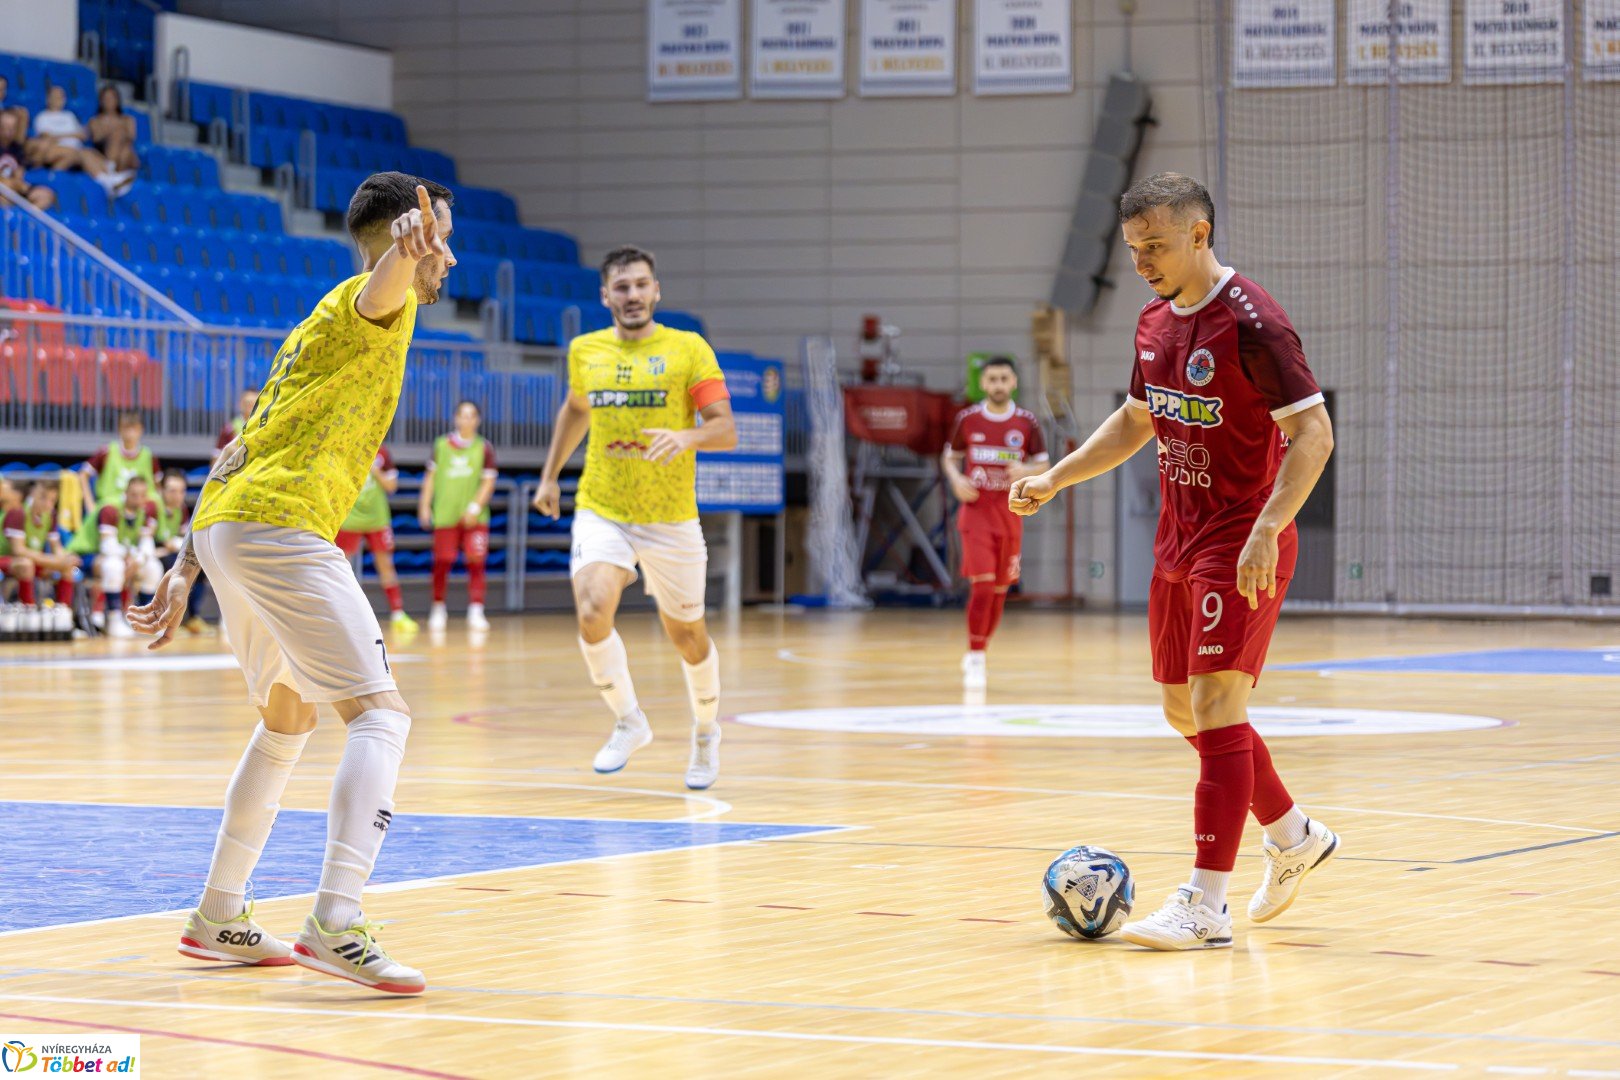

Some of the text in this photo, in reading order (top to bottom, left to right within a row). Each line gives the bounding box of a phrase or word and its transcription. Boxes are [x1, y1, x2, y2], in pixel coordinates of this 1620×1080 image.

[1141, 350, 1155, 361] JAKO
[1202, 592, 1223, 632] 9
[1198, 644, 1224, 656] JAKO
[1193, 833, 1216, 842] AKO
